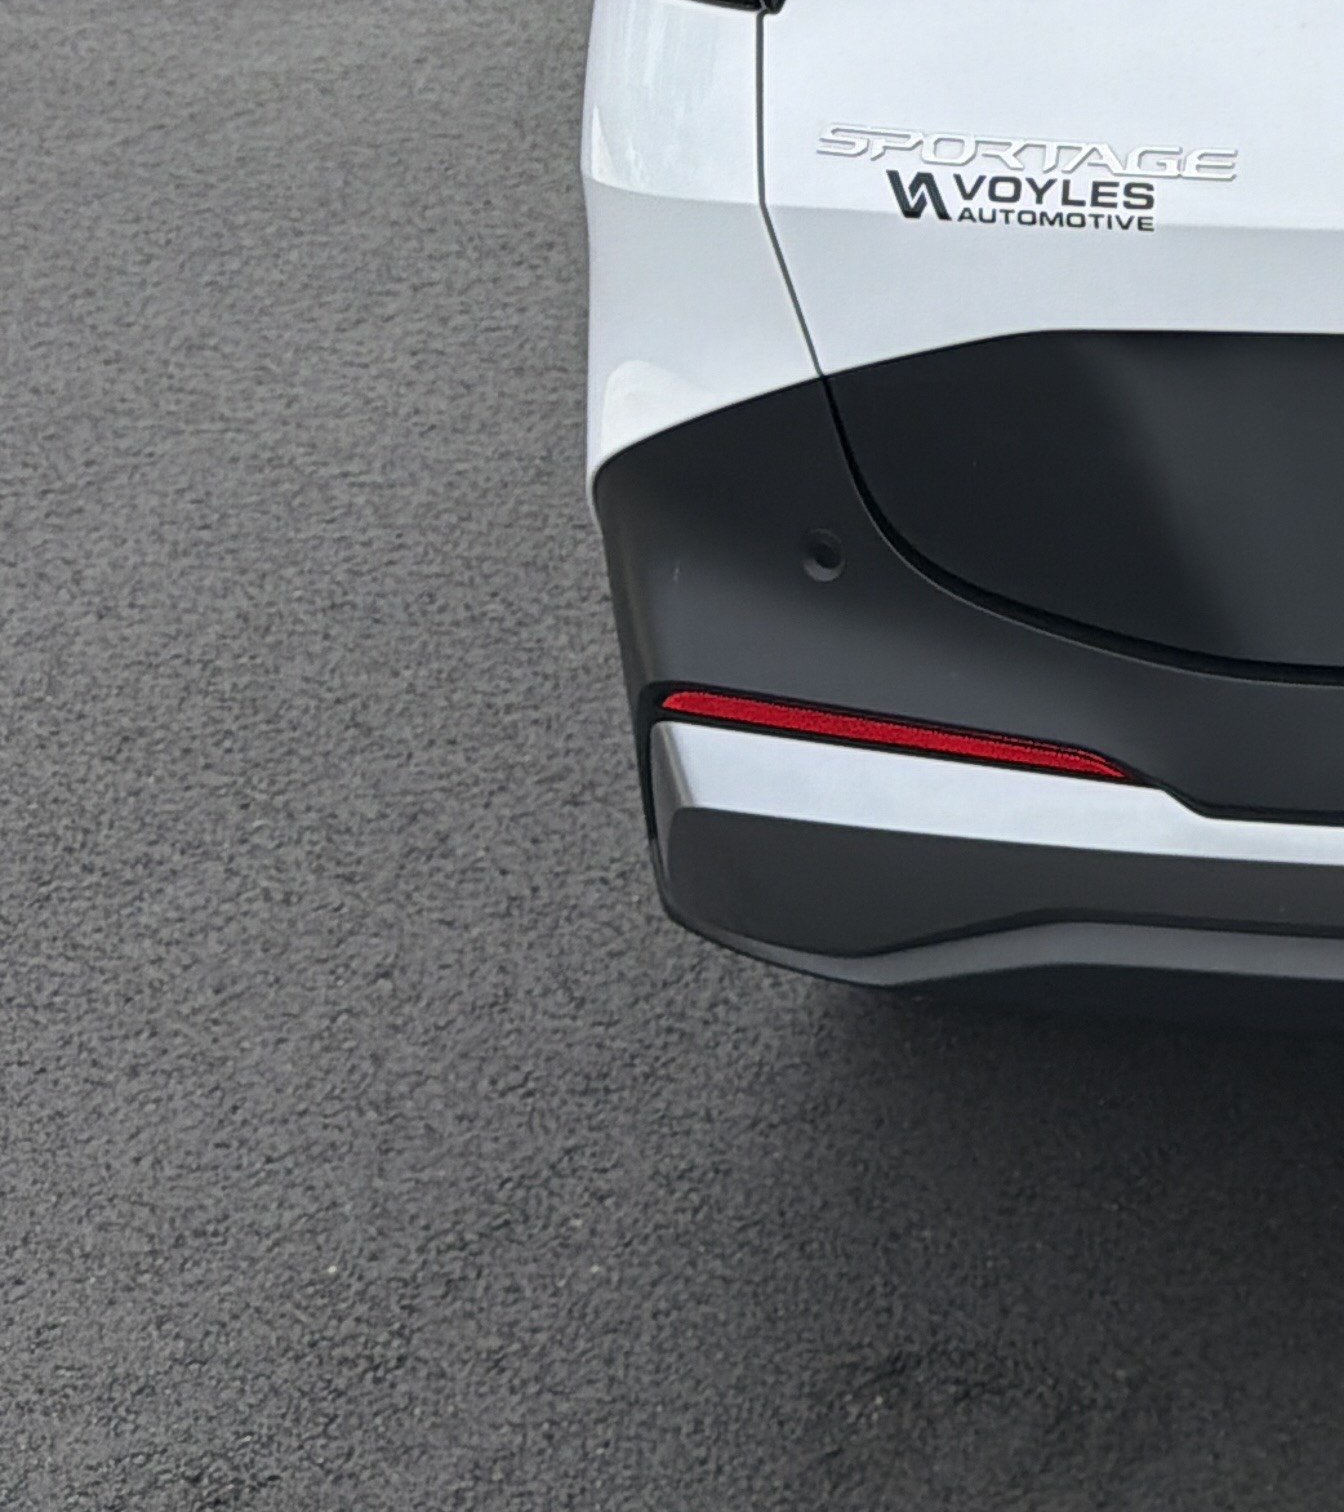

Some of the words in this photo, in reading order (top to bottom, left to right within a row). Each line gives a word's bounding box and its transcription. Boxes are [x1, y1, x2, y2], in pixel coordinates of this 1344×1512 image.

[816, 121, 1239, 182] SPORTAGE
[953, 173, 1156, 210] VOYLES
[956, 207, 1156, 232] AUTOMOTIVE
